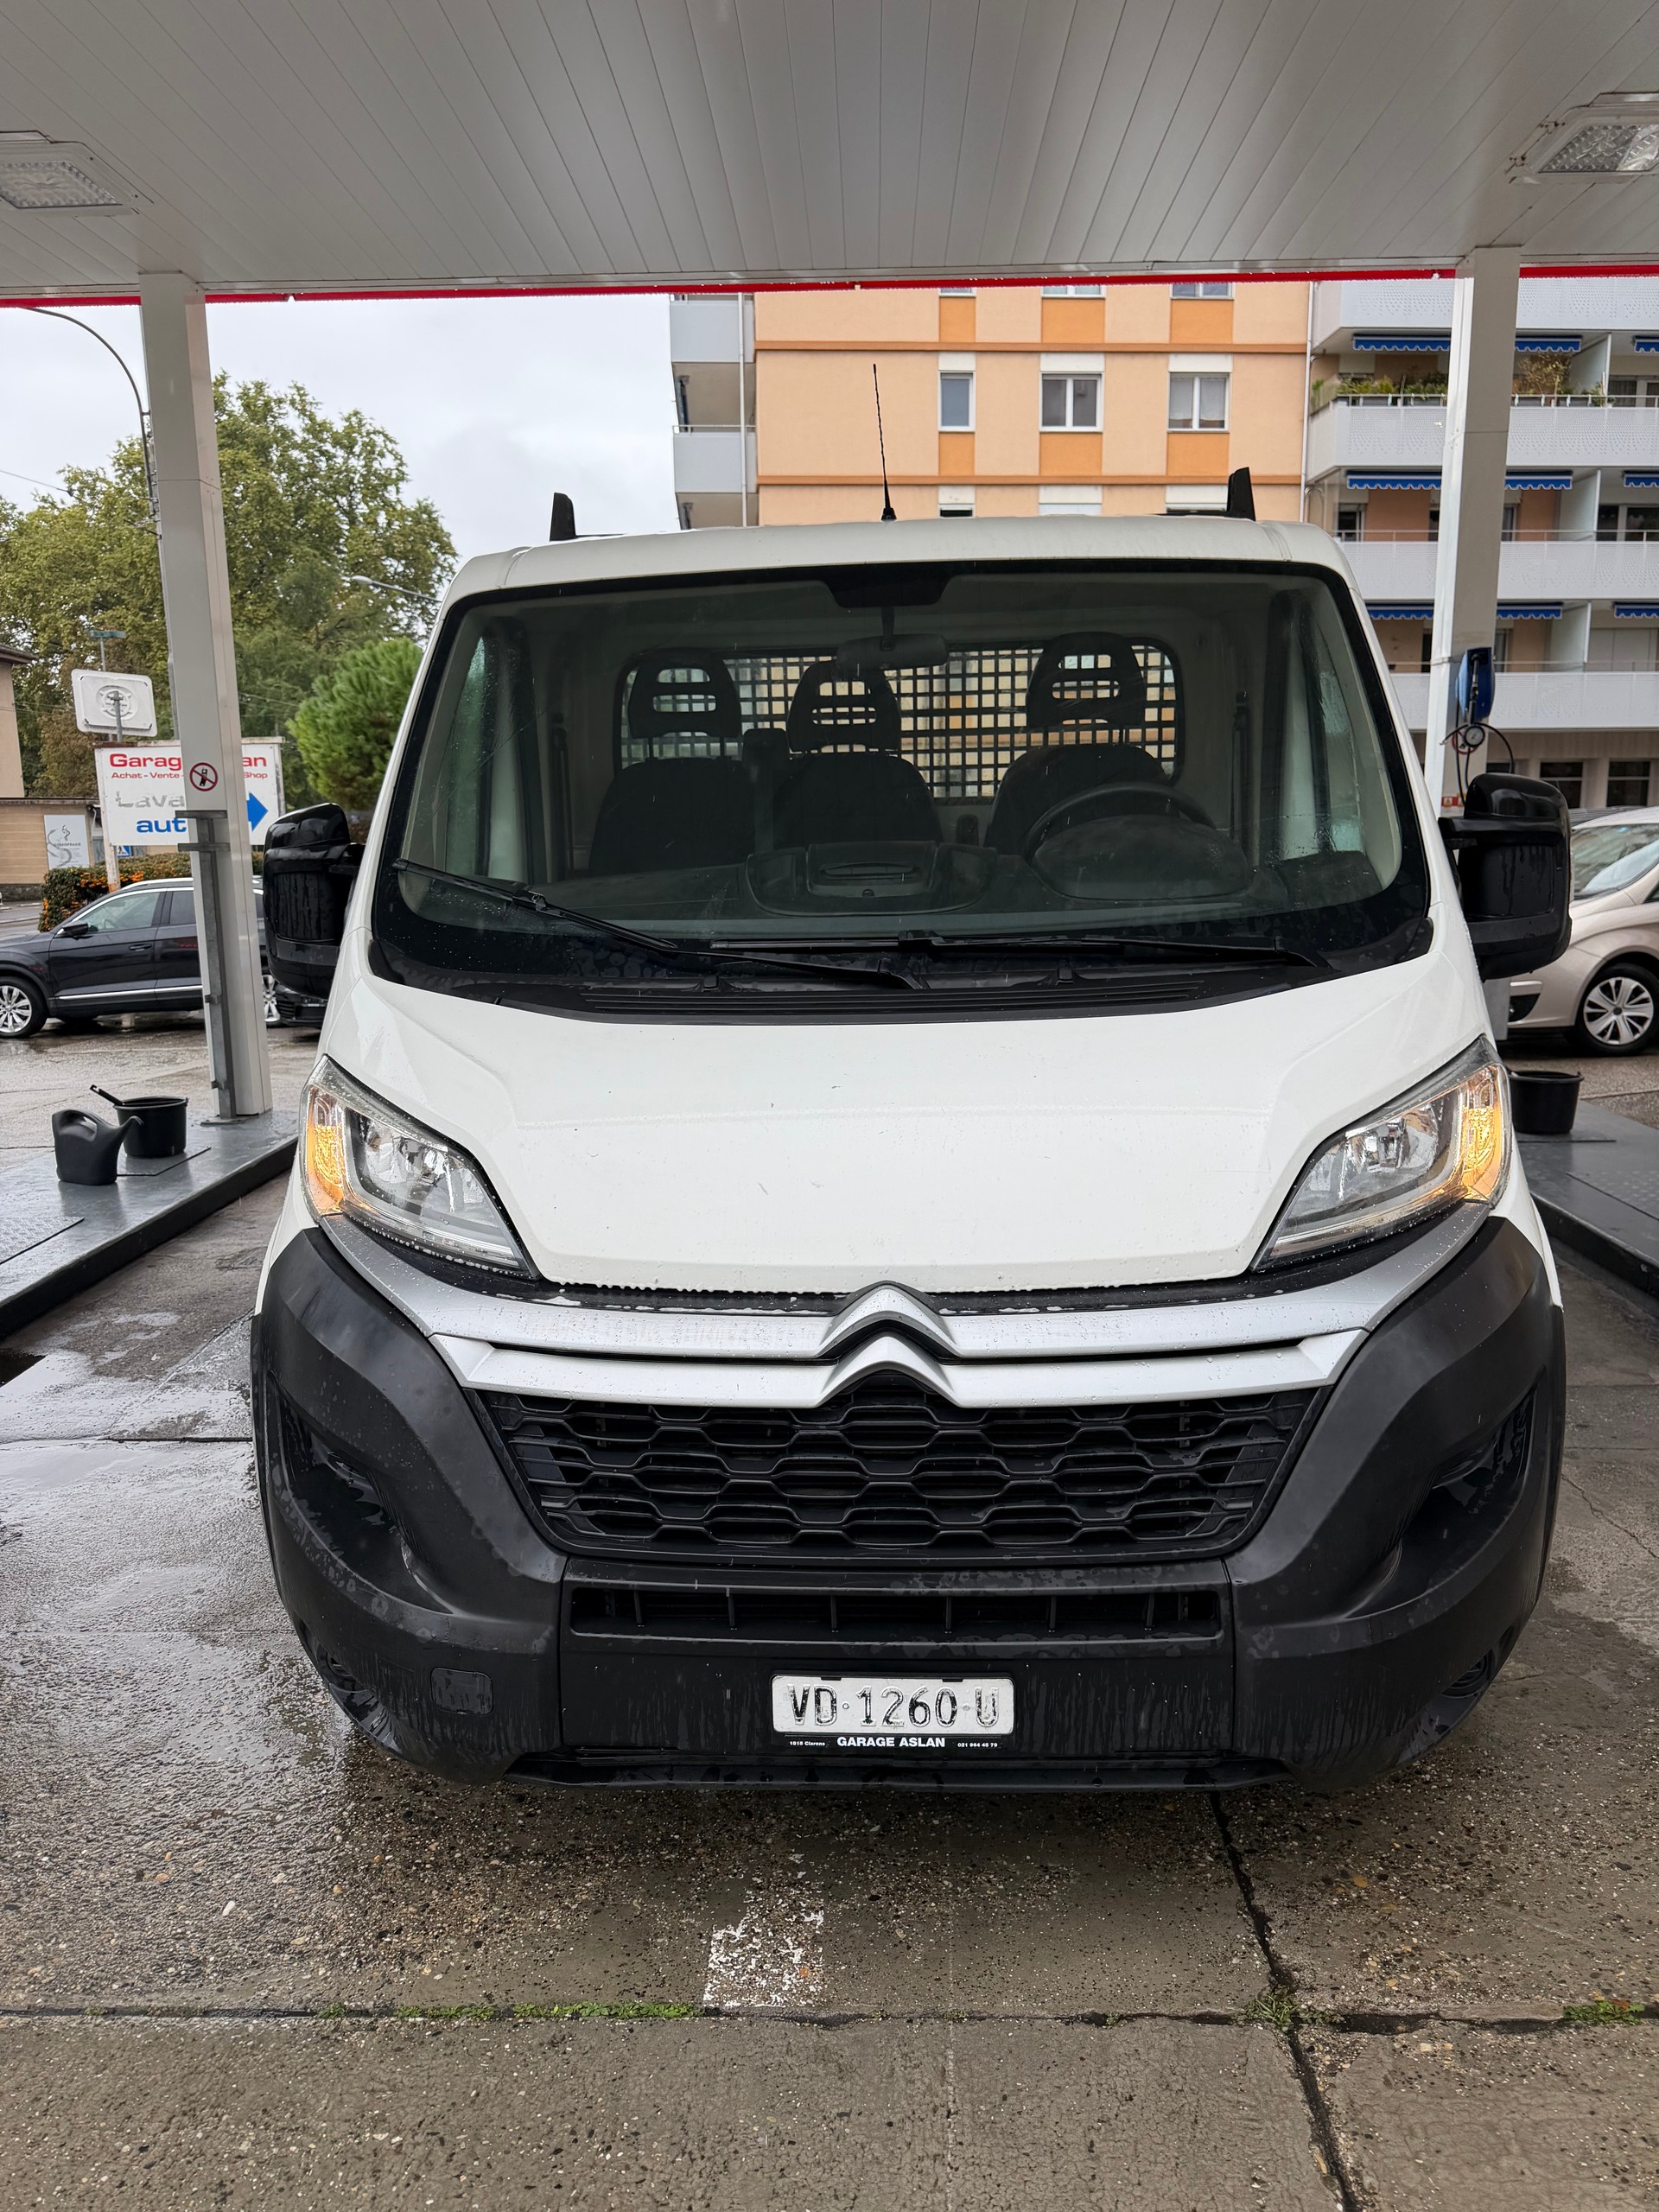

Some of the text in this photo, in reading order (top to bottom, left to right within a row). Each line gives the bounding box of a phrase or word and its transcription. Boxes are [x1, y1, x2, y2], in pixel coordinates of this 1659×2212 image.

[110, 753, 182, 771] Garag
[116, 791, 185, 808] Lava
[137, 817, 187, 833] aut
[787, 1683, 1000, 1727] VD 1260 U
[836, 1736, 895, 1747] GARAGE
[899, 1737, 945, 1748] ASLAN
